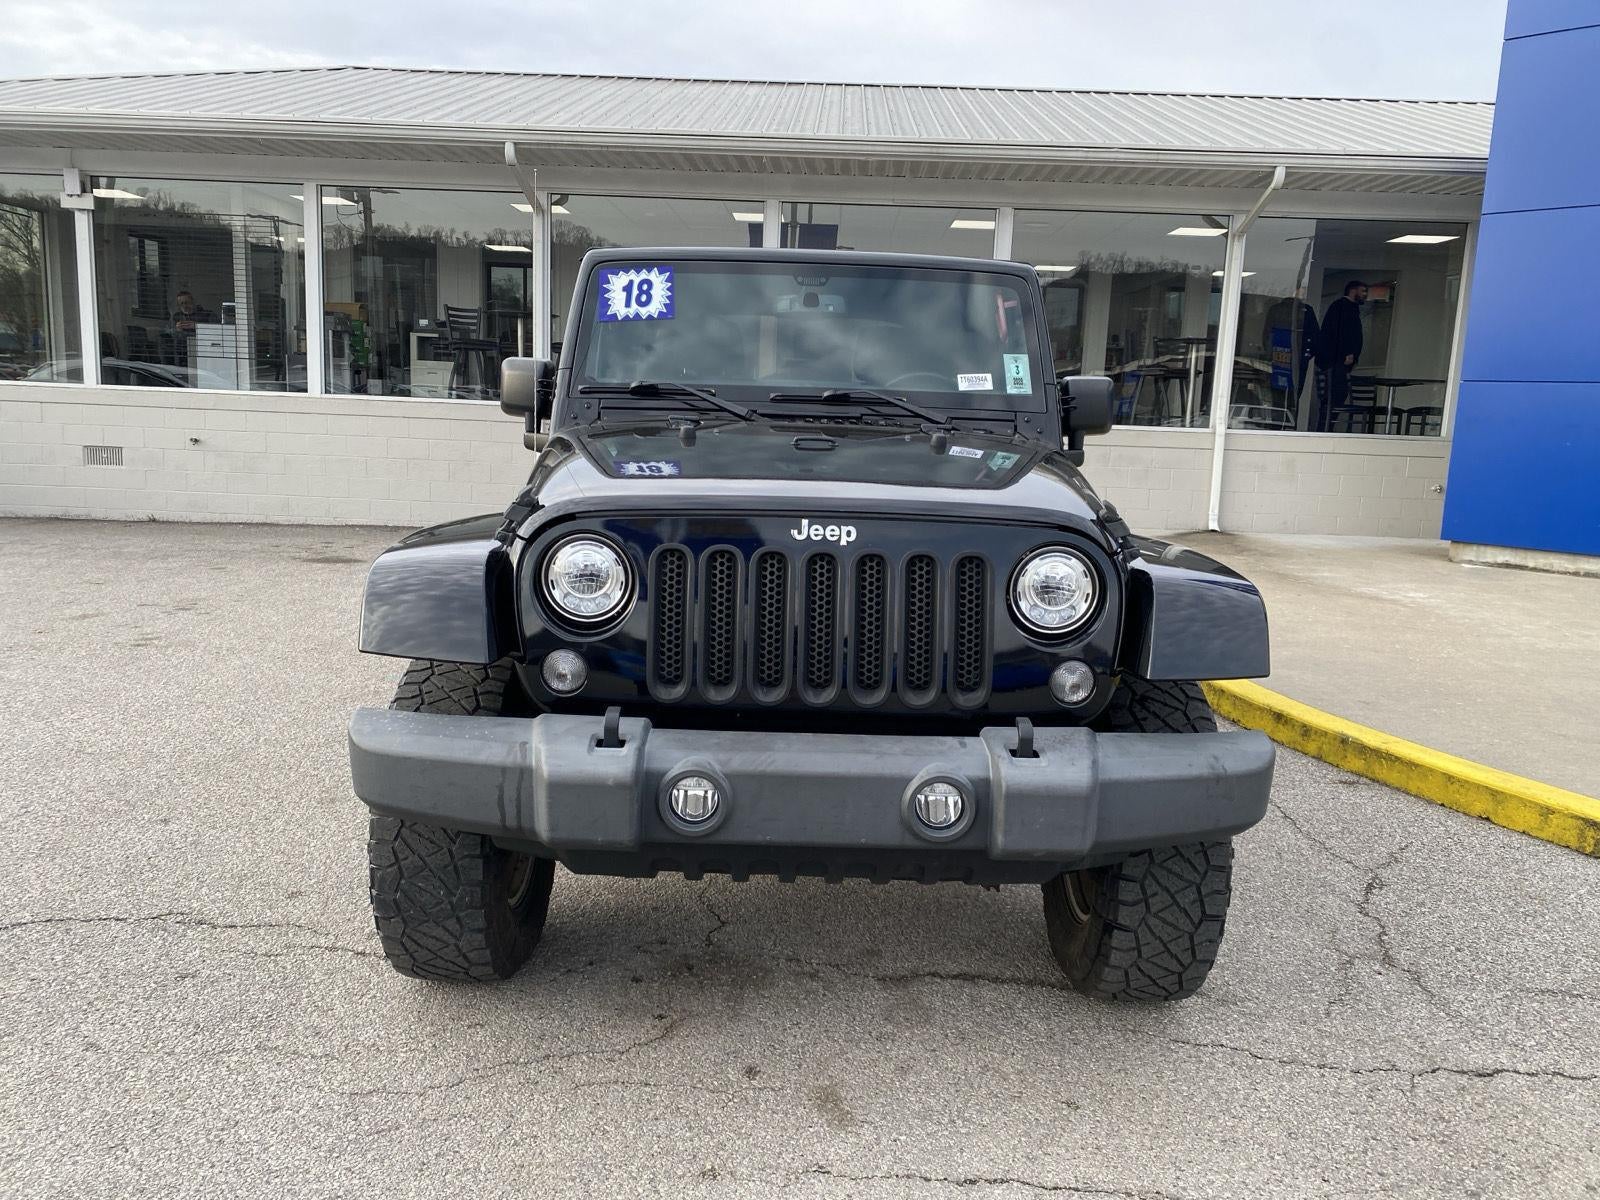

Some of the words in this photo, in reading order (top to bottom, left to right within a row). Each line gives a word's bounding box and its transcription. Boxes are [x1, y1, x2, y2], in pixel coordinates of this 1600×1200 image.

[622, 278, 653, 308] 18
[1015, 365, 1020, 375] 3
[790, 518, 857, 546] Jeep
